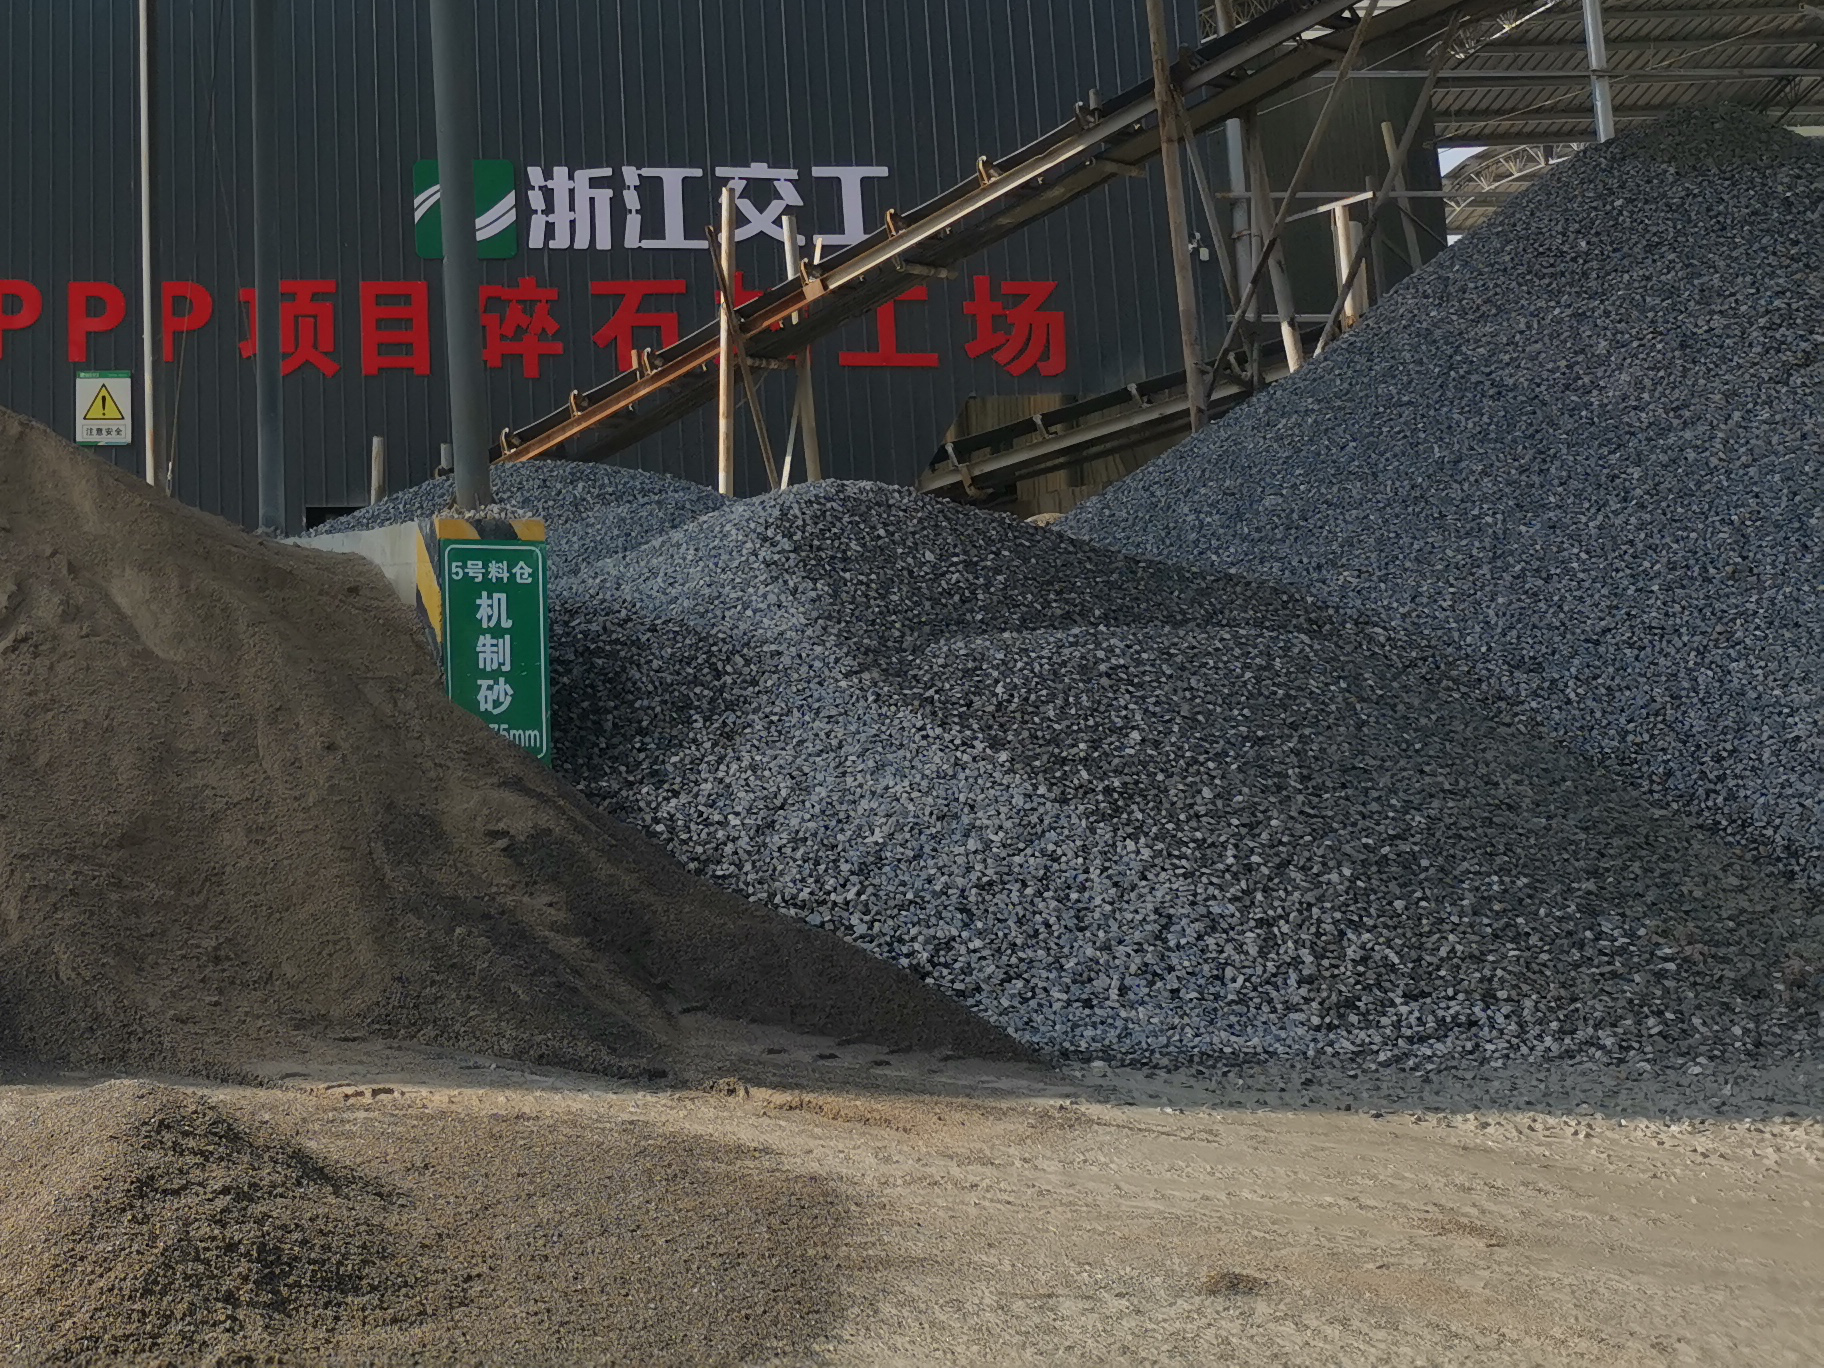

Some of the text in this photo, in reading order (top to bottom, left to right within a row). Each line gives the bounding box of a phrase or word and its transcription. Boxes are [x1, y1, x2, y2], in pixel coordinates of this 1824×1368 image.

[527, 162, 889, 250] 浙江交工
[85, 427, 123, 436] 注意安全
[451, 560, 533, 584] 5号料仓
[476, 591, 513, 715] 机制砂
